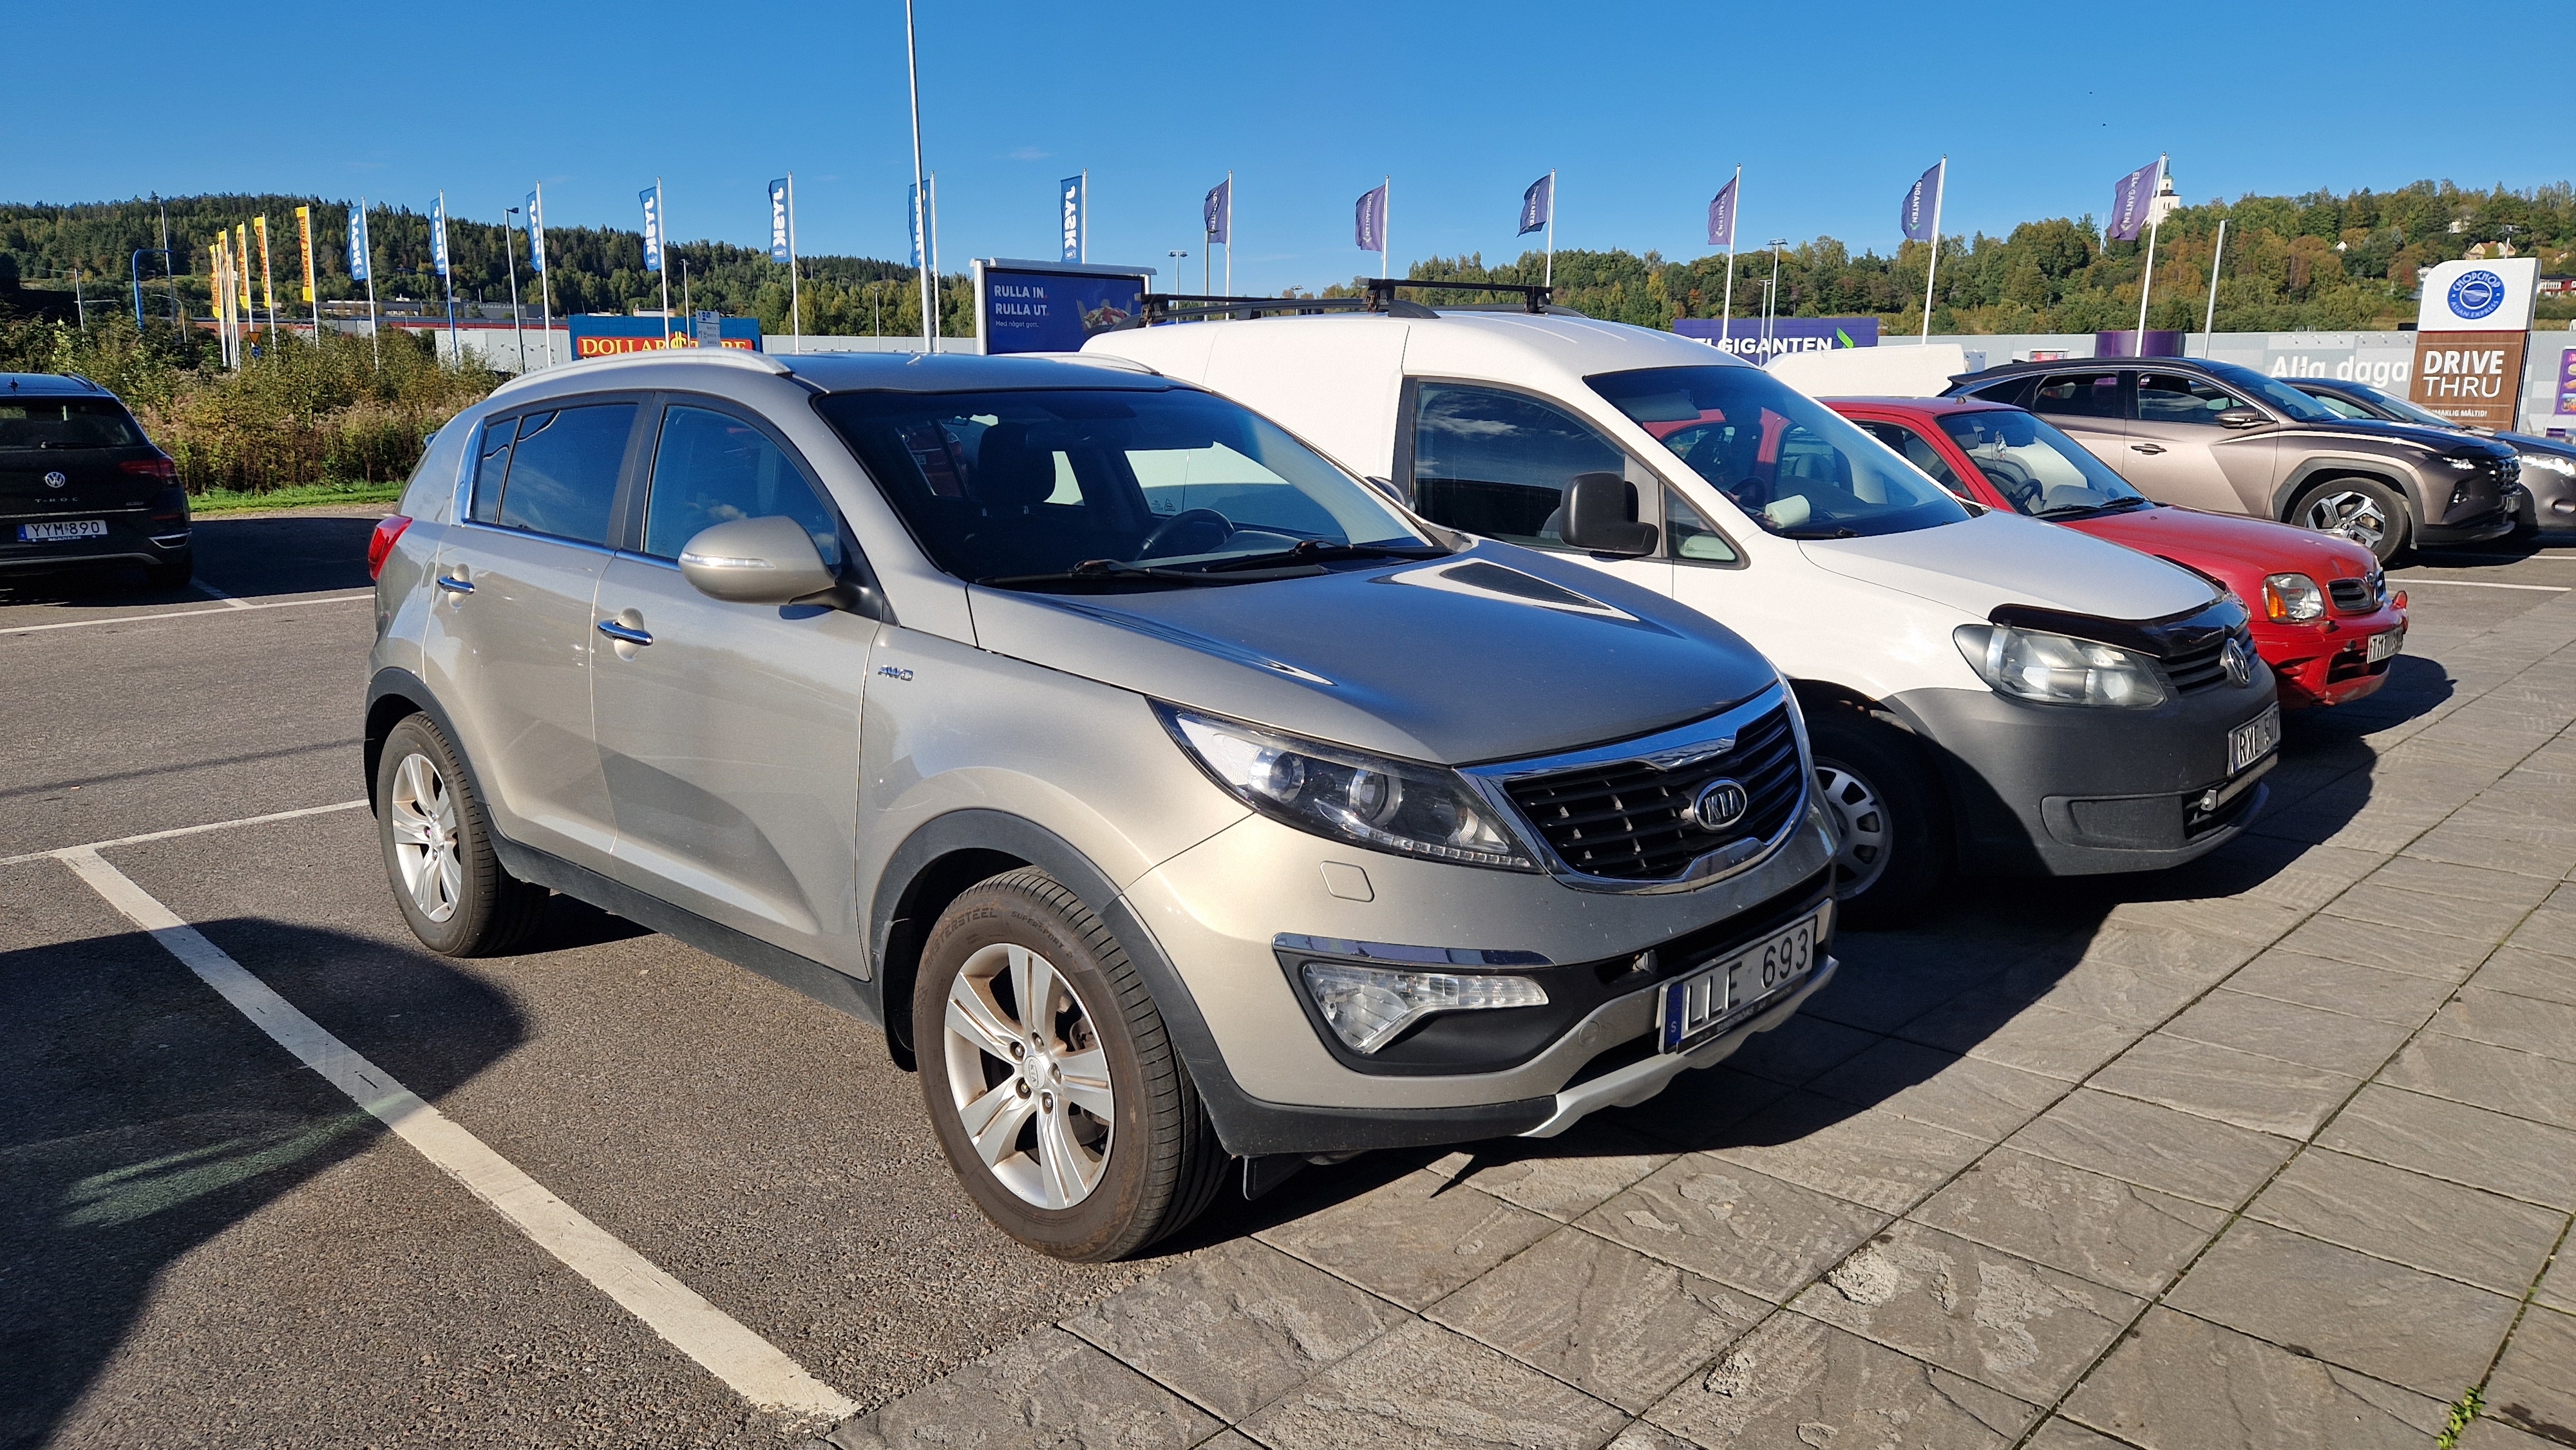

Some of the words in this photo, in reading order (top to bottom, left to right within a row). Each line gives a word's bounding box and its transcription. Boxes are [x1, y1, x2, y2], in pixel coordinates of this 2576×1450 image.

[1912, 181, 1922, 223] GIGANTEN
[994, 285, 1030, 297] RULLA
[995, 303, 1031, 315] RULLA
[2450, 301, 2470, 317] ASIAN
[2470, 300, 2499, 318] EXPRESS
[2269, 355, 2326, 379] Alla
[2424, 350, 2505, 374] DRIVE
[2423, 376, 2501, 397] THRU
[2460, 408, 2487, 418] MÅLTID!
[31, 523, 64, 537] YYM
[69, 521, 100, 534] 890
[1704, 789, 1741, 824] KIA
[1010, 910, 1065, 949] SUPERSPORT
[1685, 961, 1743, 1031] LLE
[1761, 928, 1808, 989] 693
[1671, 1021, 1677, 1033] S
